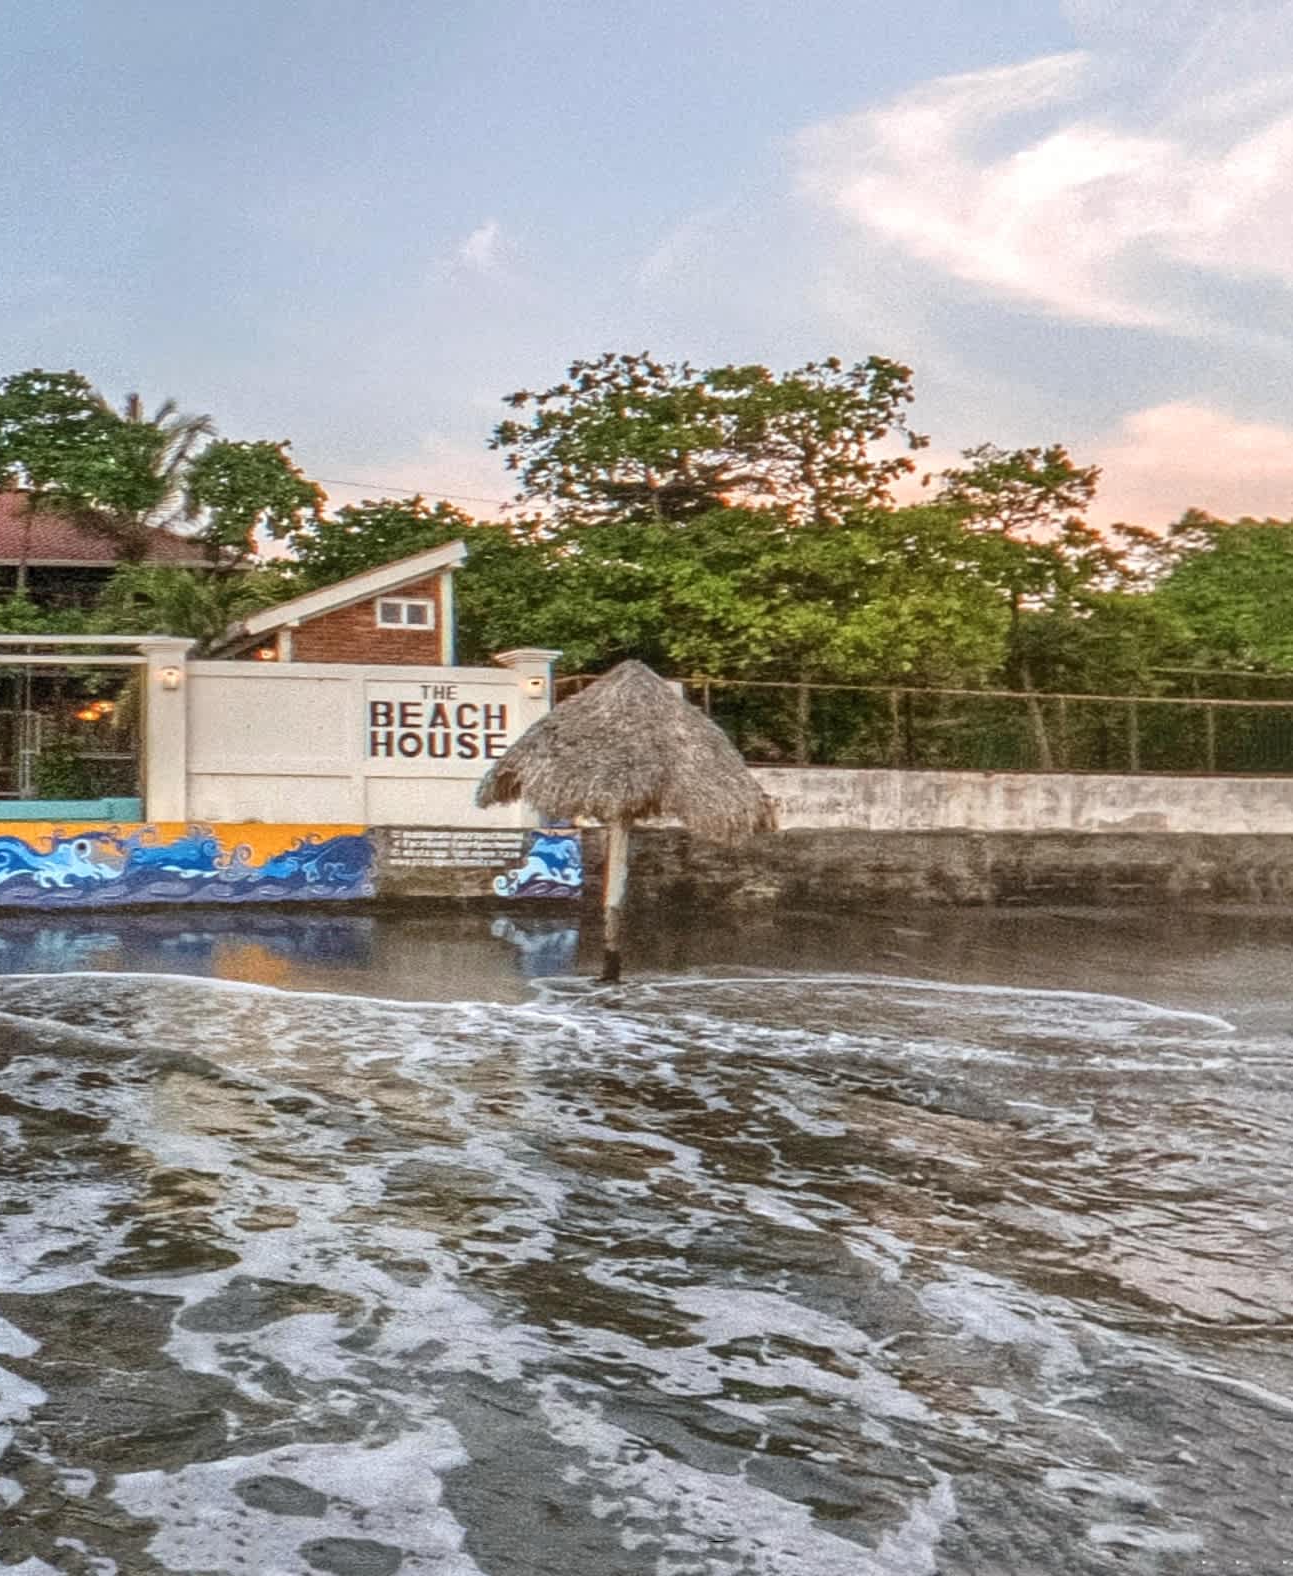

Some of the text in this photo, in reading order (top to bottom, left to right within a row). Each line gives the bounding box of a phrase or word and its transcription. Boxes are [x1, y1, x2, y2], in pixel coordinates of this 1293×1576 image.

[420, 685, 458, 700] THE
[370, 701, 508, 730] BEACH
[370, 731, 507, 760] HOUSE
